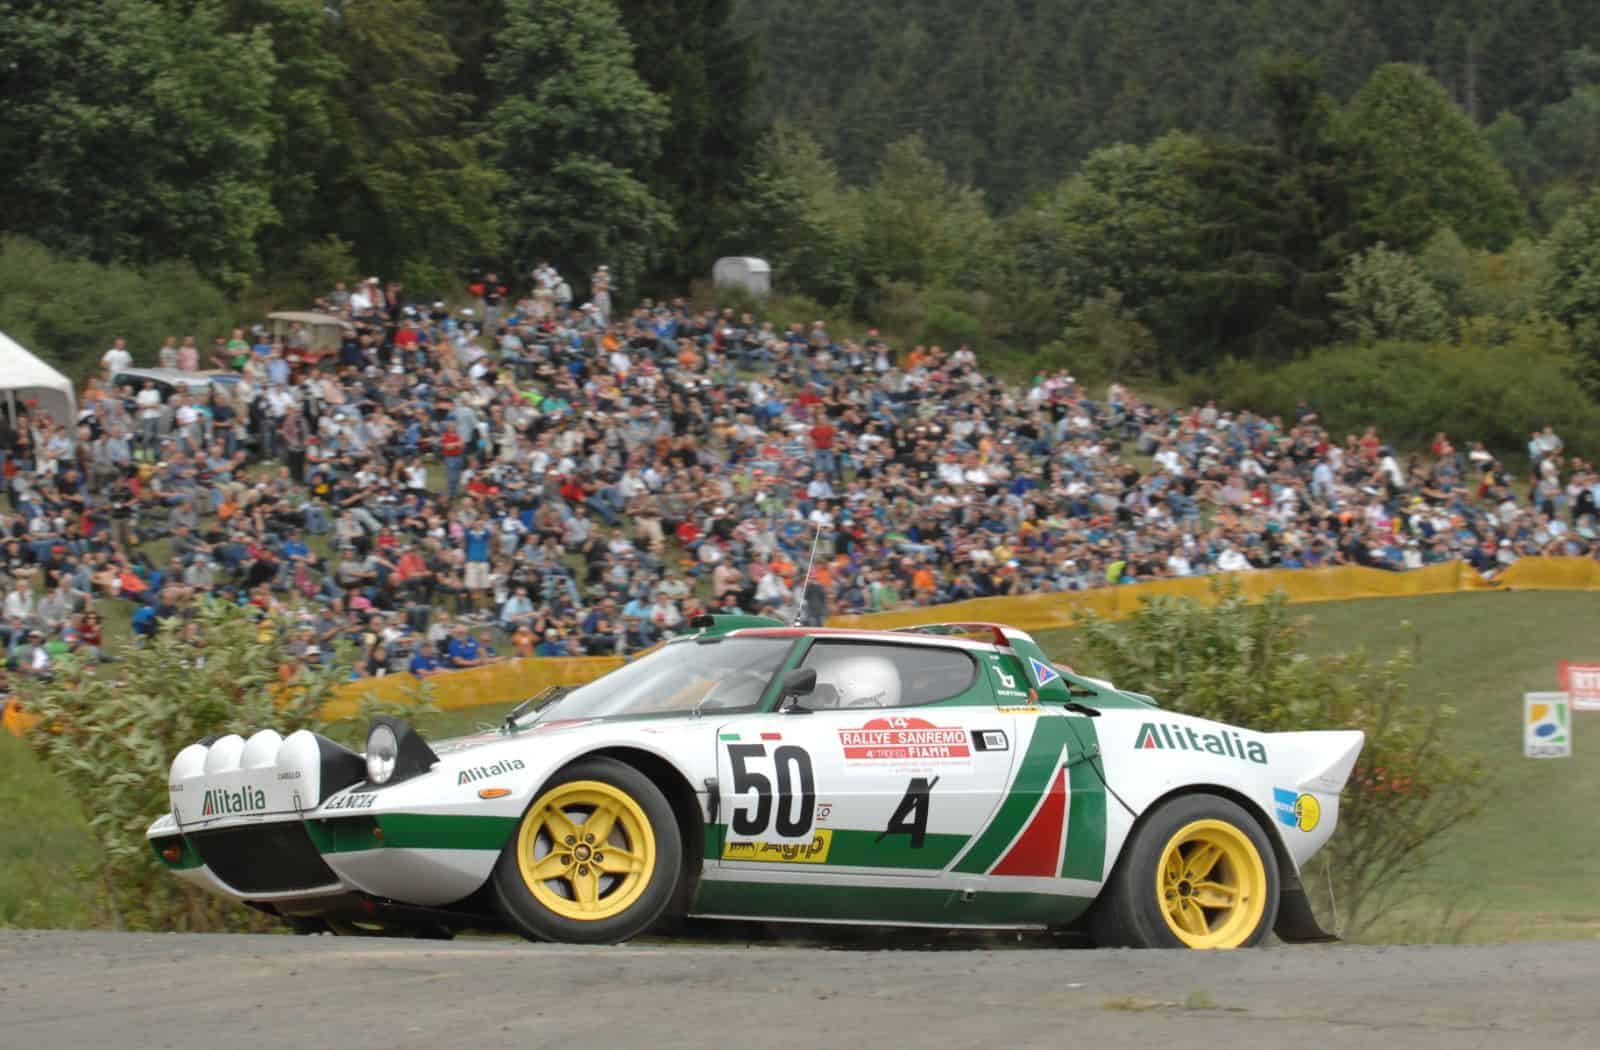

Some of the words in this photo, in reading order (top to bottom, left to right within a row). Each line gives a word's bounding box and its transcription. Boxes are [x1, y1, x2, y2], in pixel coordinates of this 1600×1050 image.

[886, 717, 909, 729] 14
[842, 732, 891, 745] RALLYE
[897, 731, 965, 745] SANREMO
[1133, 722, 1268, 765] Alitalia
[908, 747, 950, 758] FIAMM
[456, 759, 526, 786] Alitalia
[202, 784, 267, 816] Alitalia
[324, 793, 378, 809] LANCIA
[726, 743, 816, 838] 50
